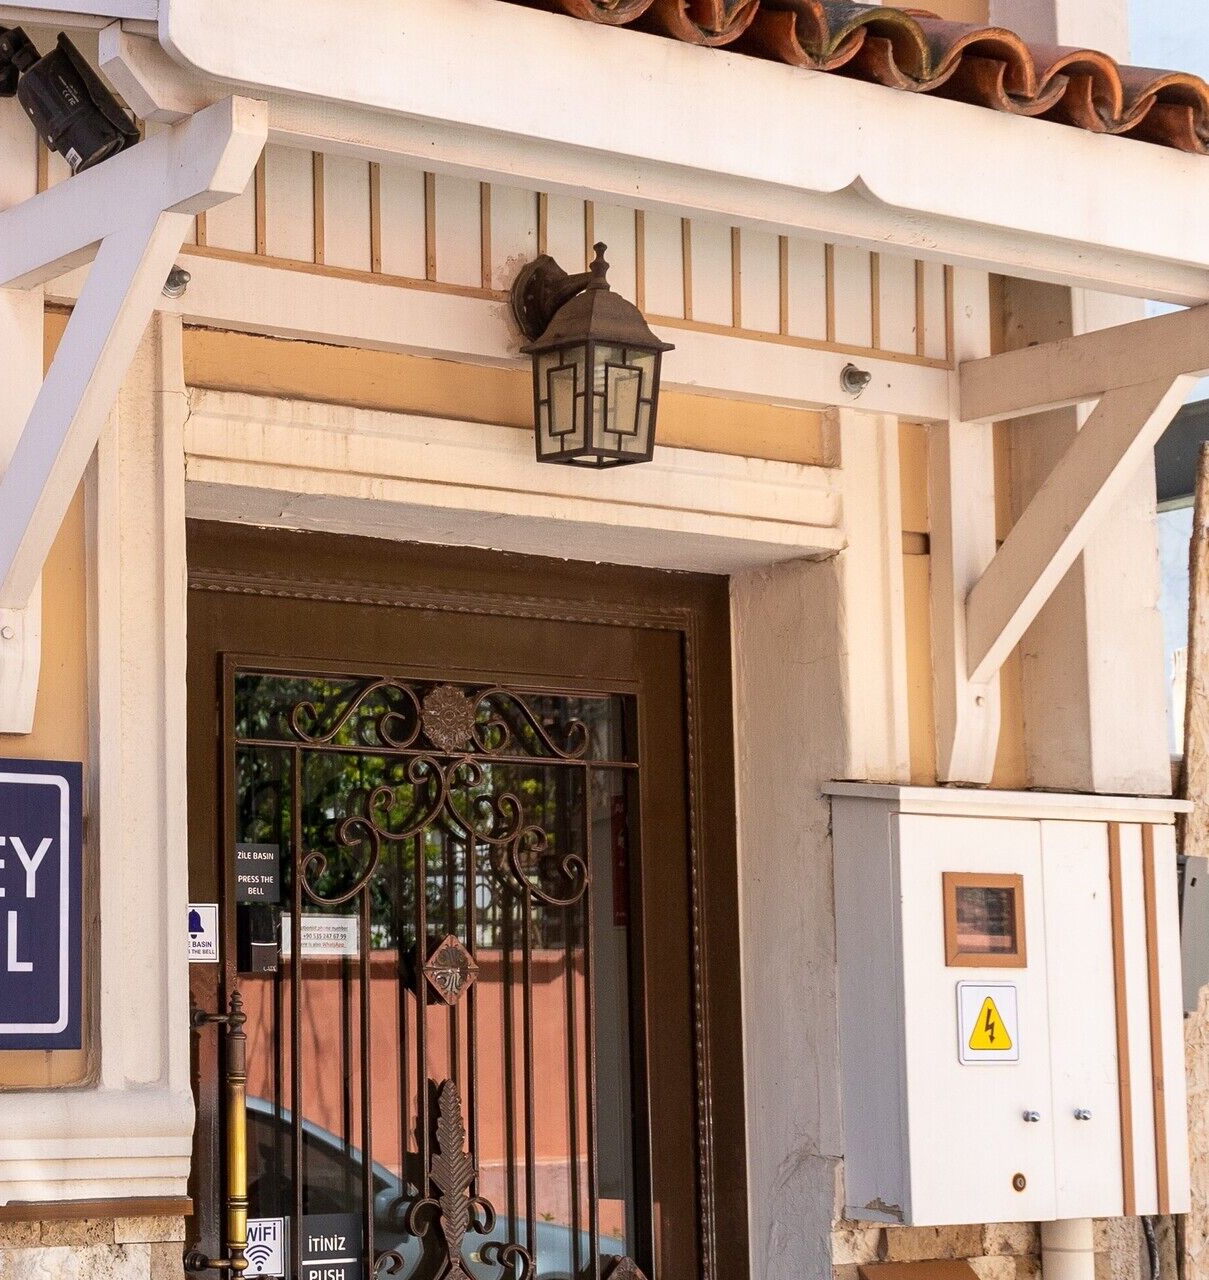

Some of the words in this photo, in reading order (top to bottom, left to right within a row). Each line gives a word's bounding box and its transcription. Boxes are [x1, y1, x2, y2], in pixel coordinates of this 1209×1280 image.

[253, 852, 274, 860] BASIN
[238, 875, 260, 883] PRESS
[260, 876, 274, 884] THE
[248, 887, 264, 895] BELL
[308, 1234, 346, 1252] İTİNİZ
